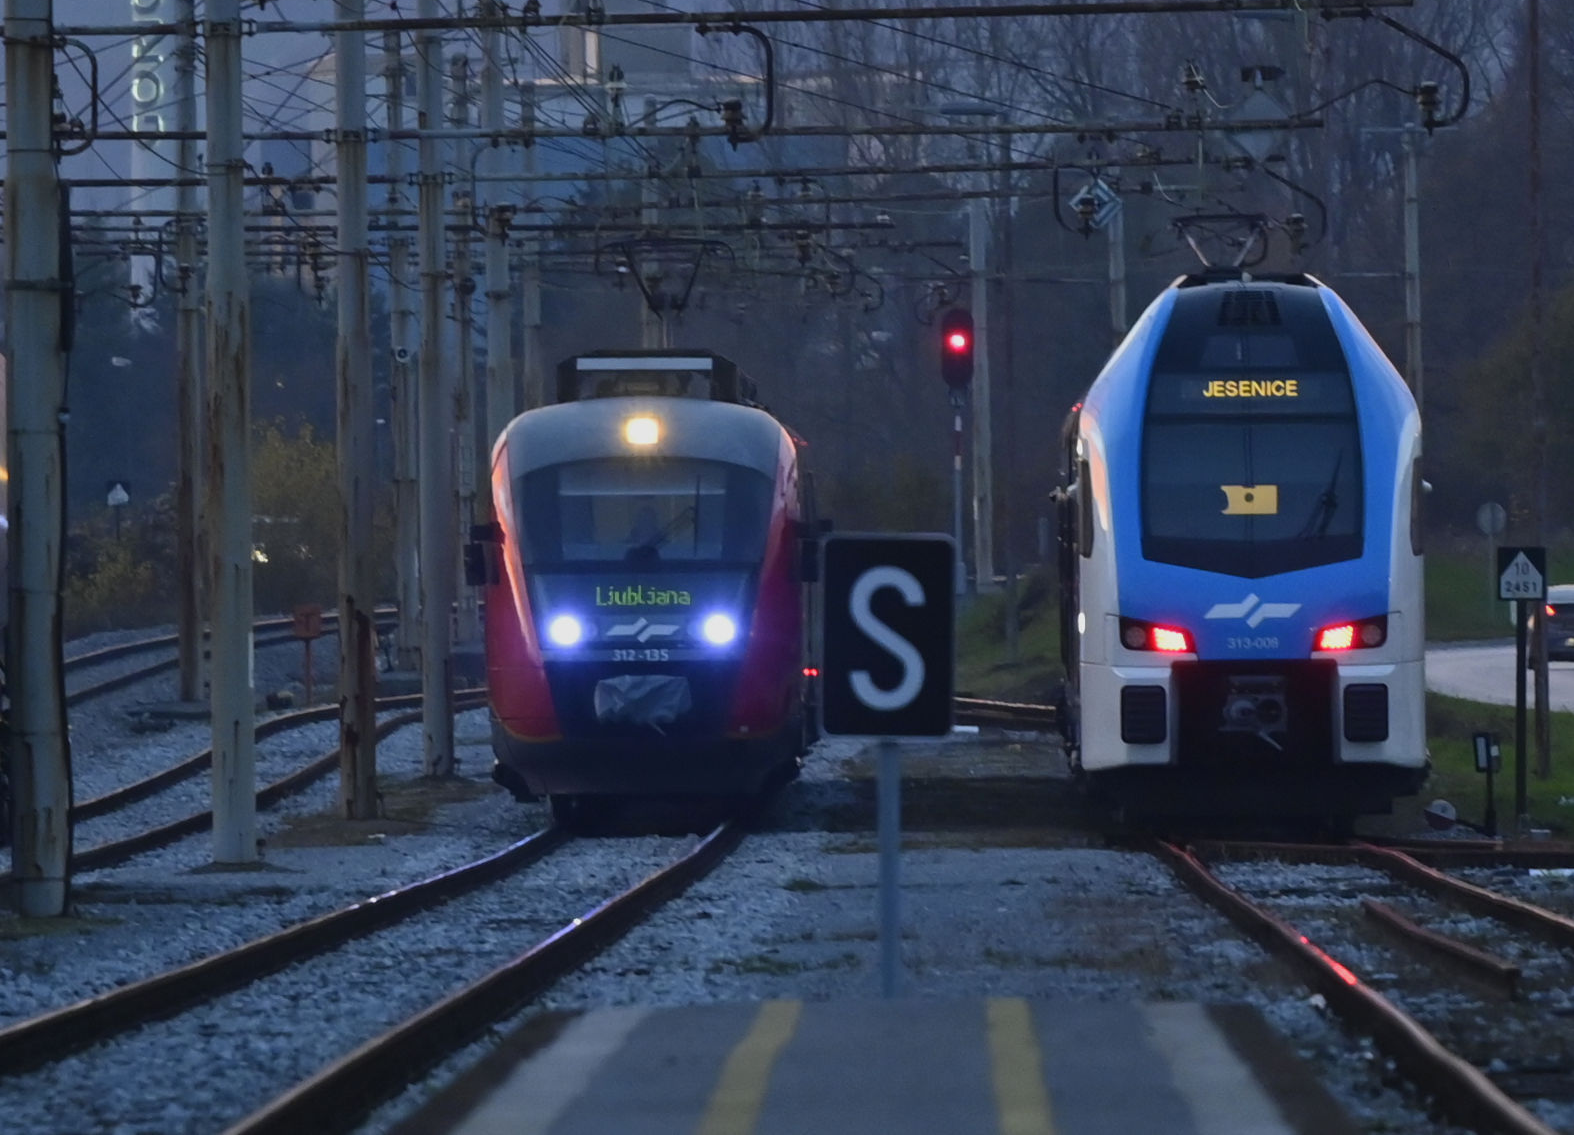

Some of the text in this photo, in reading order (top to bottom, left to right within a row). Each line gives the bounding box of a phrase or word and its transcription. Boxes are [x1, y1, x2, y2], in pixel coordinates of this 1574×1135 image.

[1202, 380, 1299, 397] JESENICE
[1515, 562, 1530, 575] 10
[595, 584, 692, 606] Ljubljana
[850, 566, 926, 711] S
